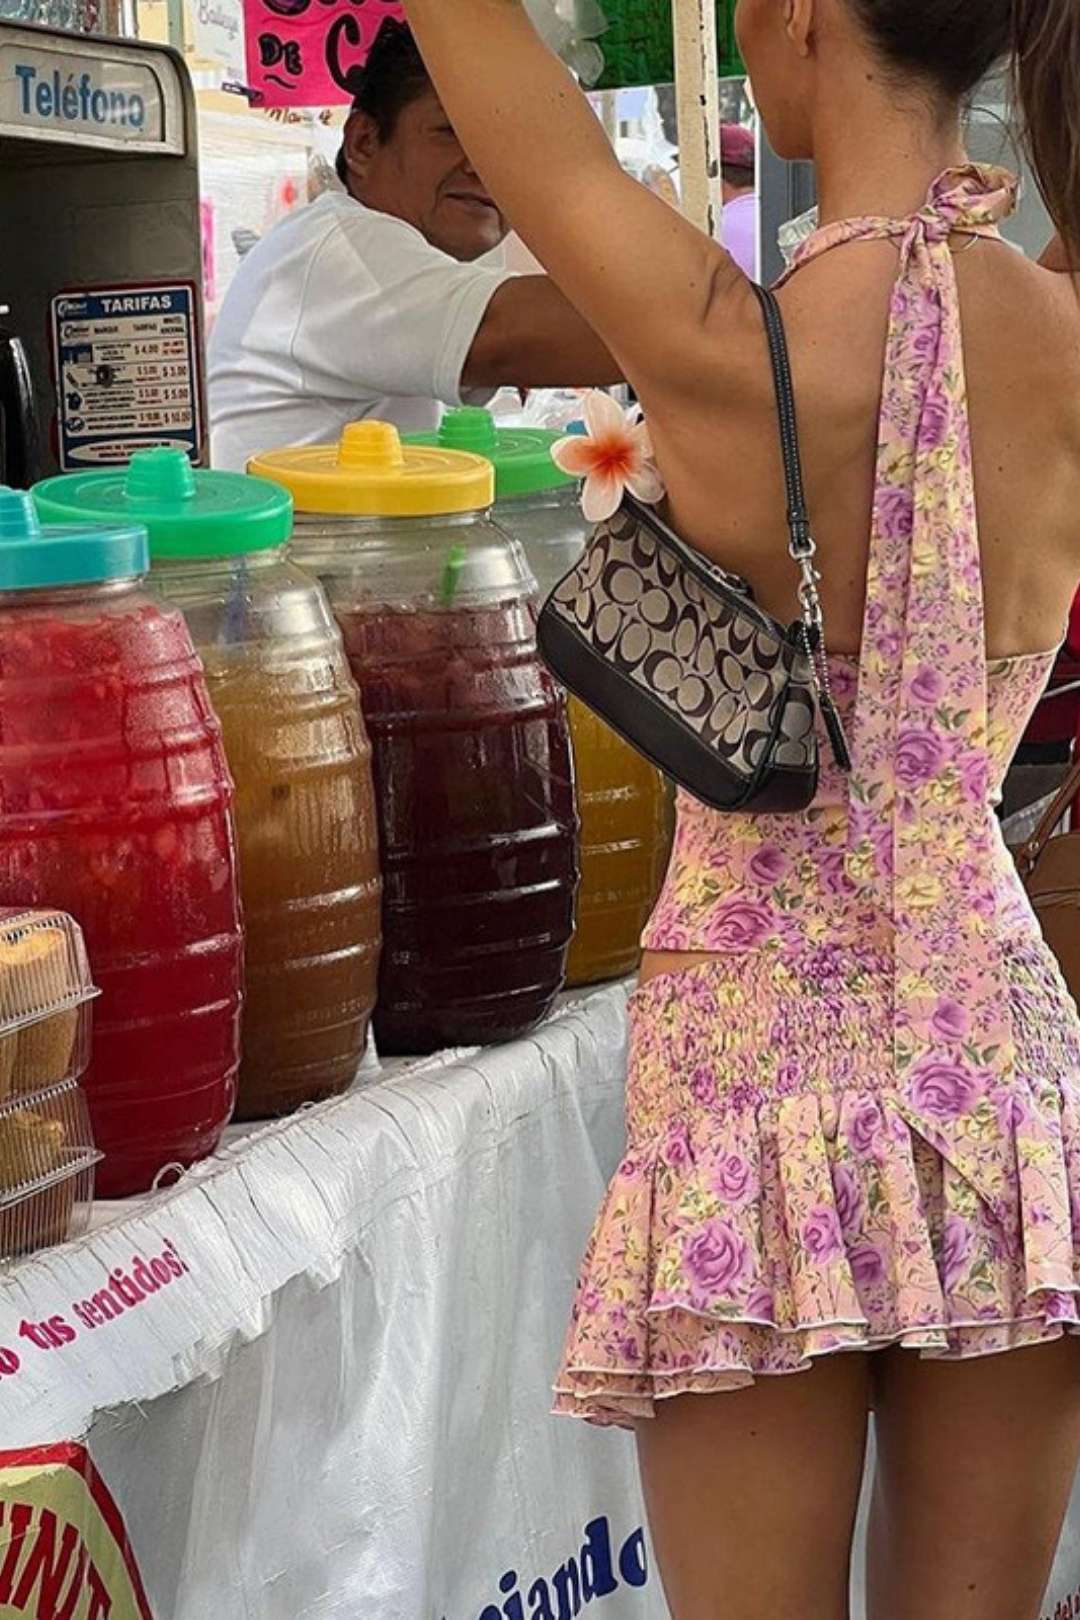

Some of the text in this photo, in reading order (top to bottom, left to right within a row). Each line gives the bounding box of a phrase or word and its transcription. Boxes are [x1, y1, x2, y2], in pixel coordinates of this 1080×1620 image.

[258, 33, 304, 75] DE
[15, 64, 145, 128] Teléfono
[101, 295, 172, 313] TARIFAS
[18, 1314, 77, 1351] tus
